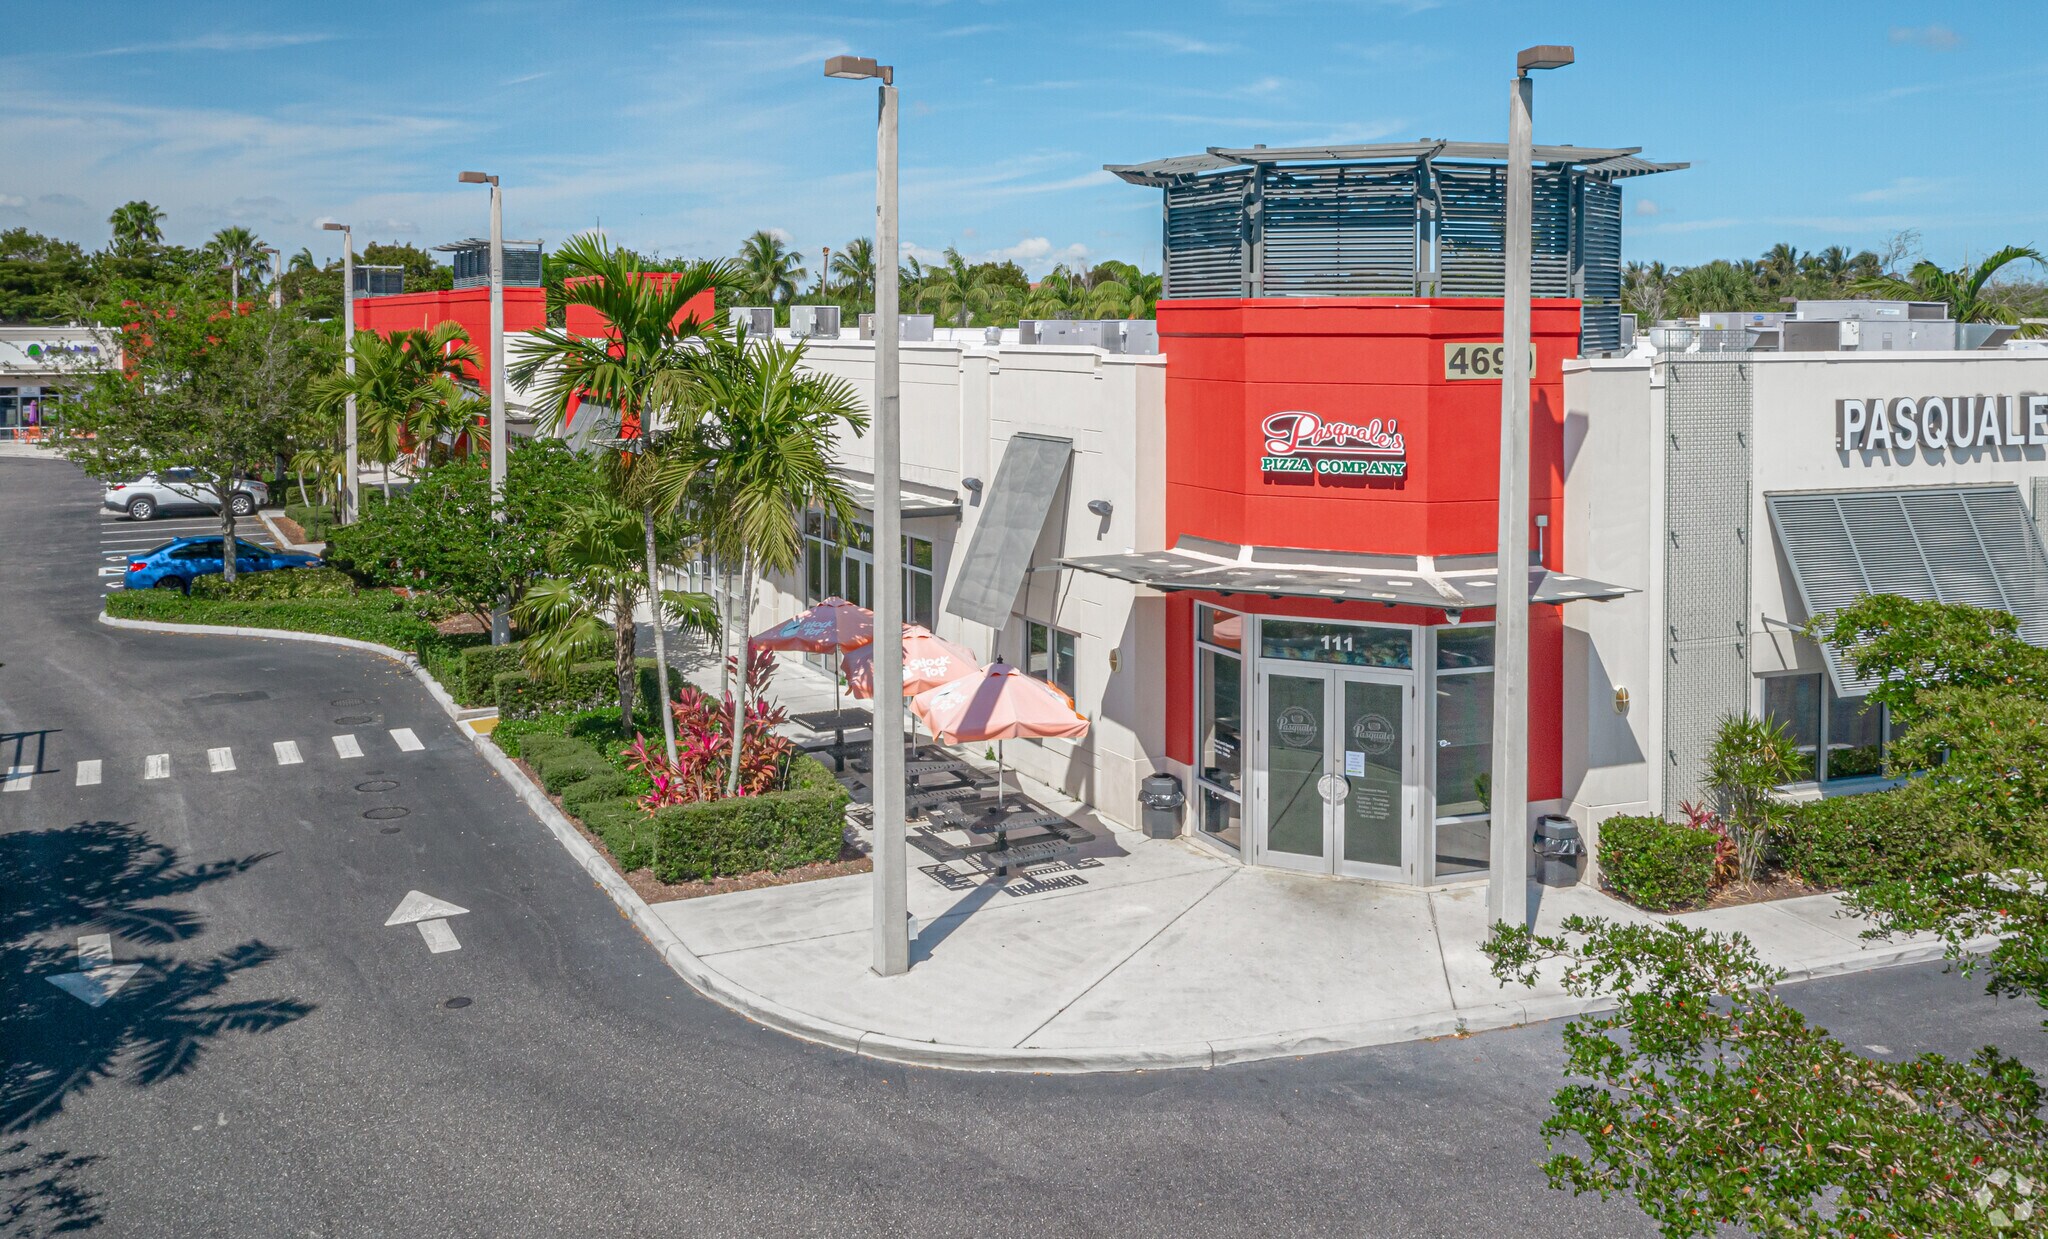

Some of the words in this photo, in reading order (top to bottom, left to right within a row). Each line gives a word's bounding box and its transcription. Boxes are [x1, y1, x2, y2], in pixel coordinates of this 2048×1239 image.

[1448, 347, 1533, 375] 469
[1262, 411, 1405, 456] Pasquale's
[1840, 395, 2048, 450] PASQUALE
[1261, 457, 1312, 472] PIZZA
[1316, 460, 1407, 476] COMPANY
[1320, 635, 1353, 652] 111
